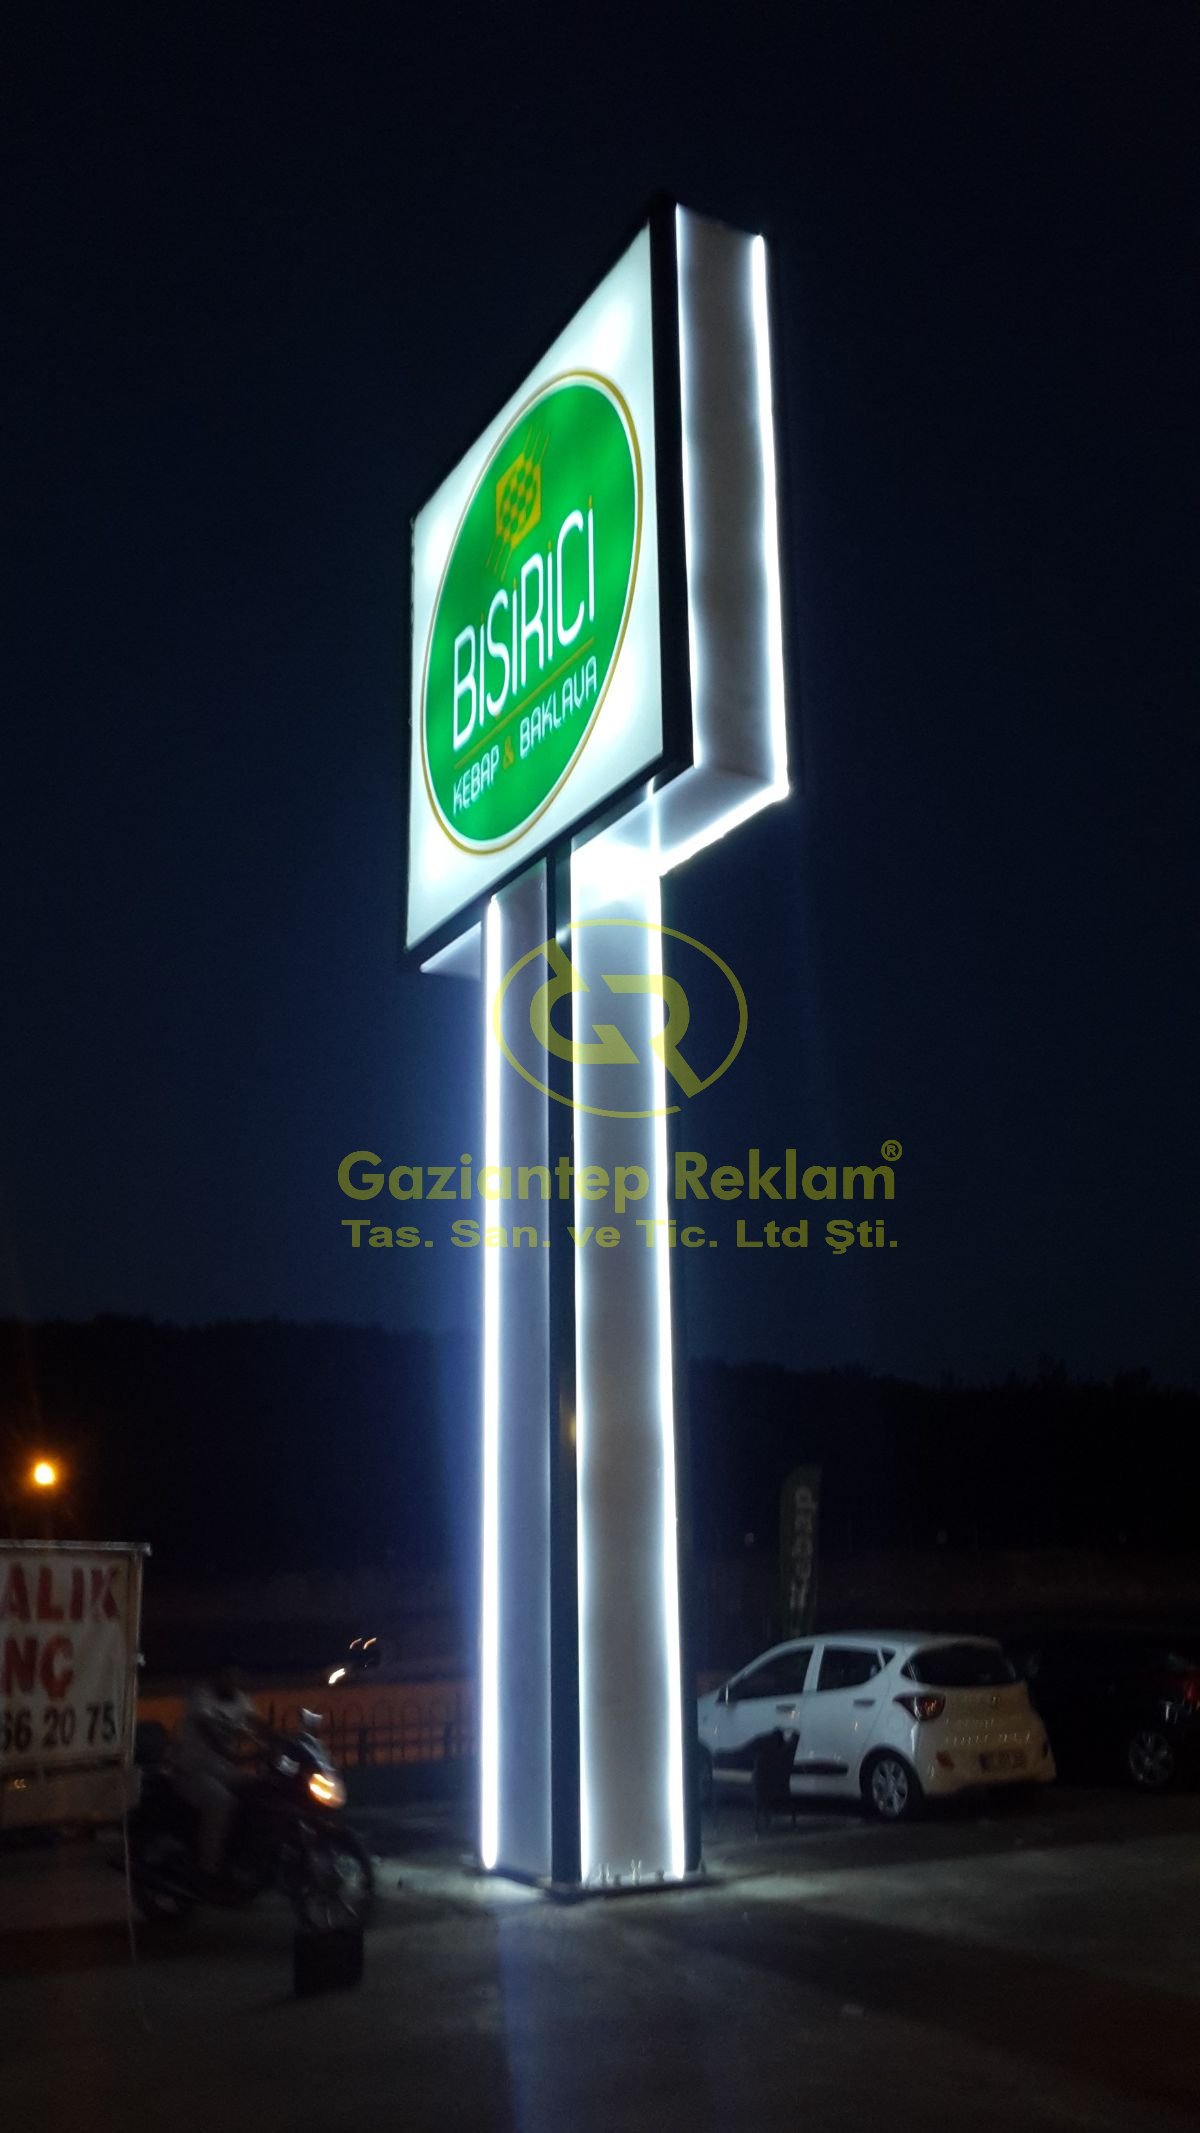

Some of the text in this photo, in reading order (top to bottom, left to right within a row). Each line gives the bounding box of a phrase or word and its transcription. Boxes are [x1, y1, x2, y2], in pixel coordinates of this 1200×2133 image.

[453, 744, 500, 816] KEBAP
[519, 655, 598, 760] BAKLAVA
[42, 1704, 76, 1749] 20
